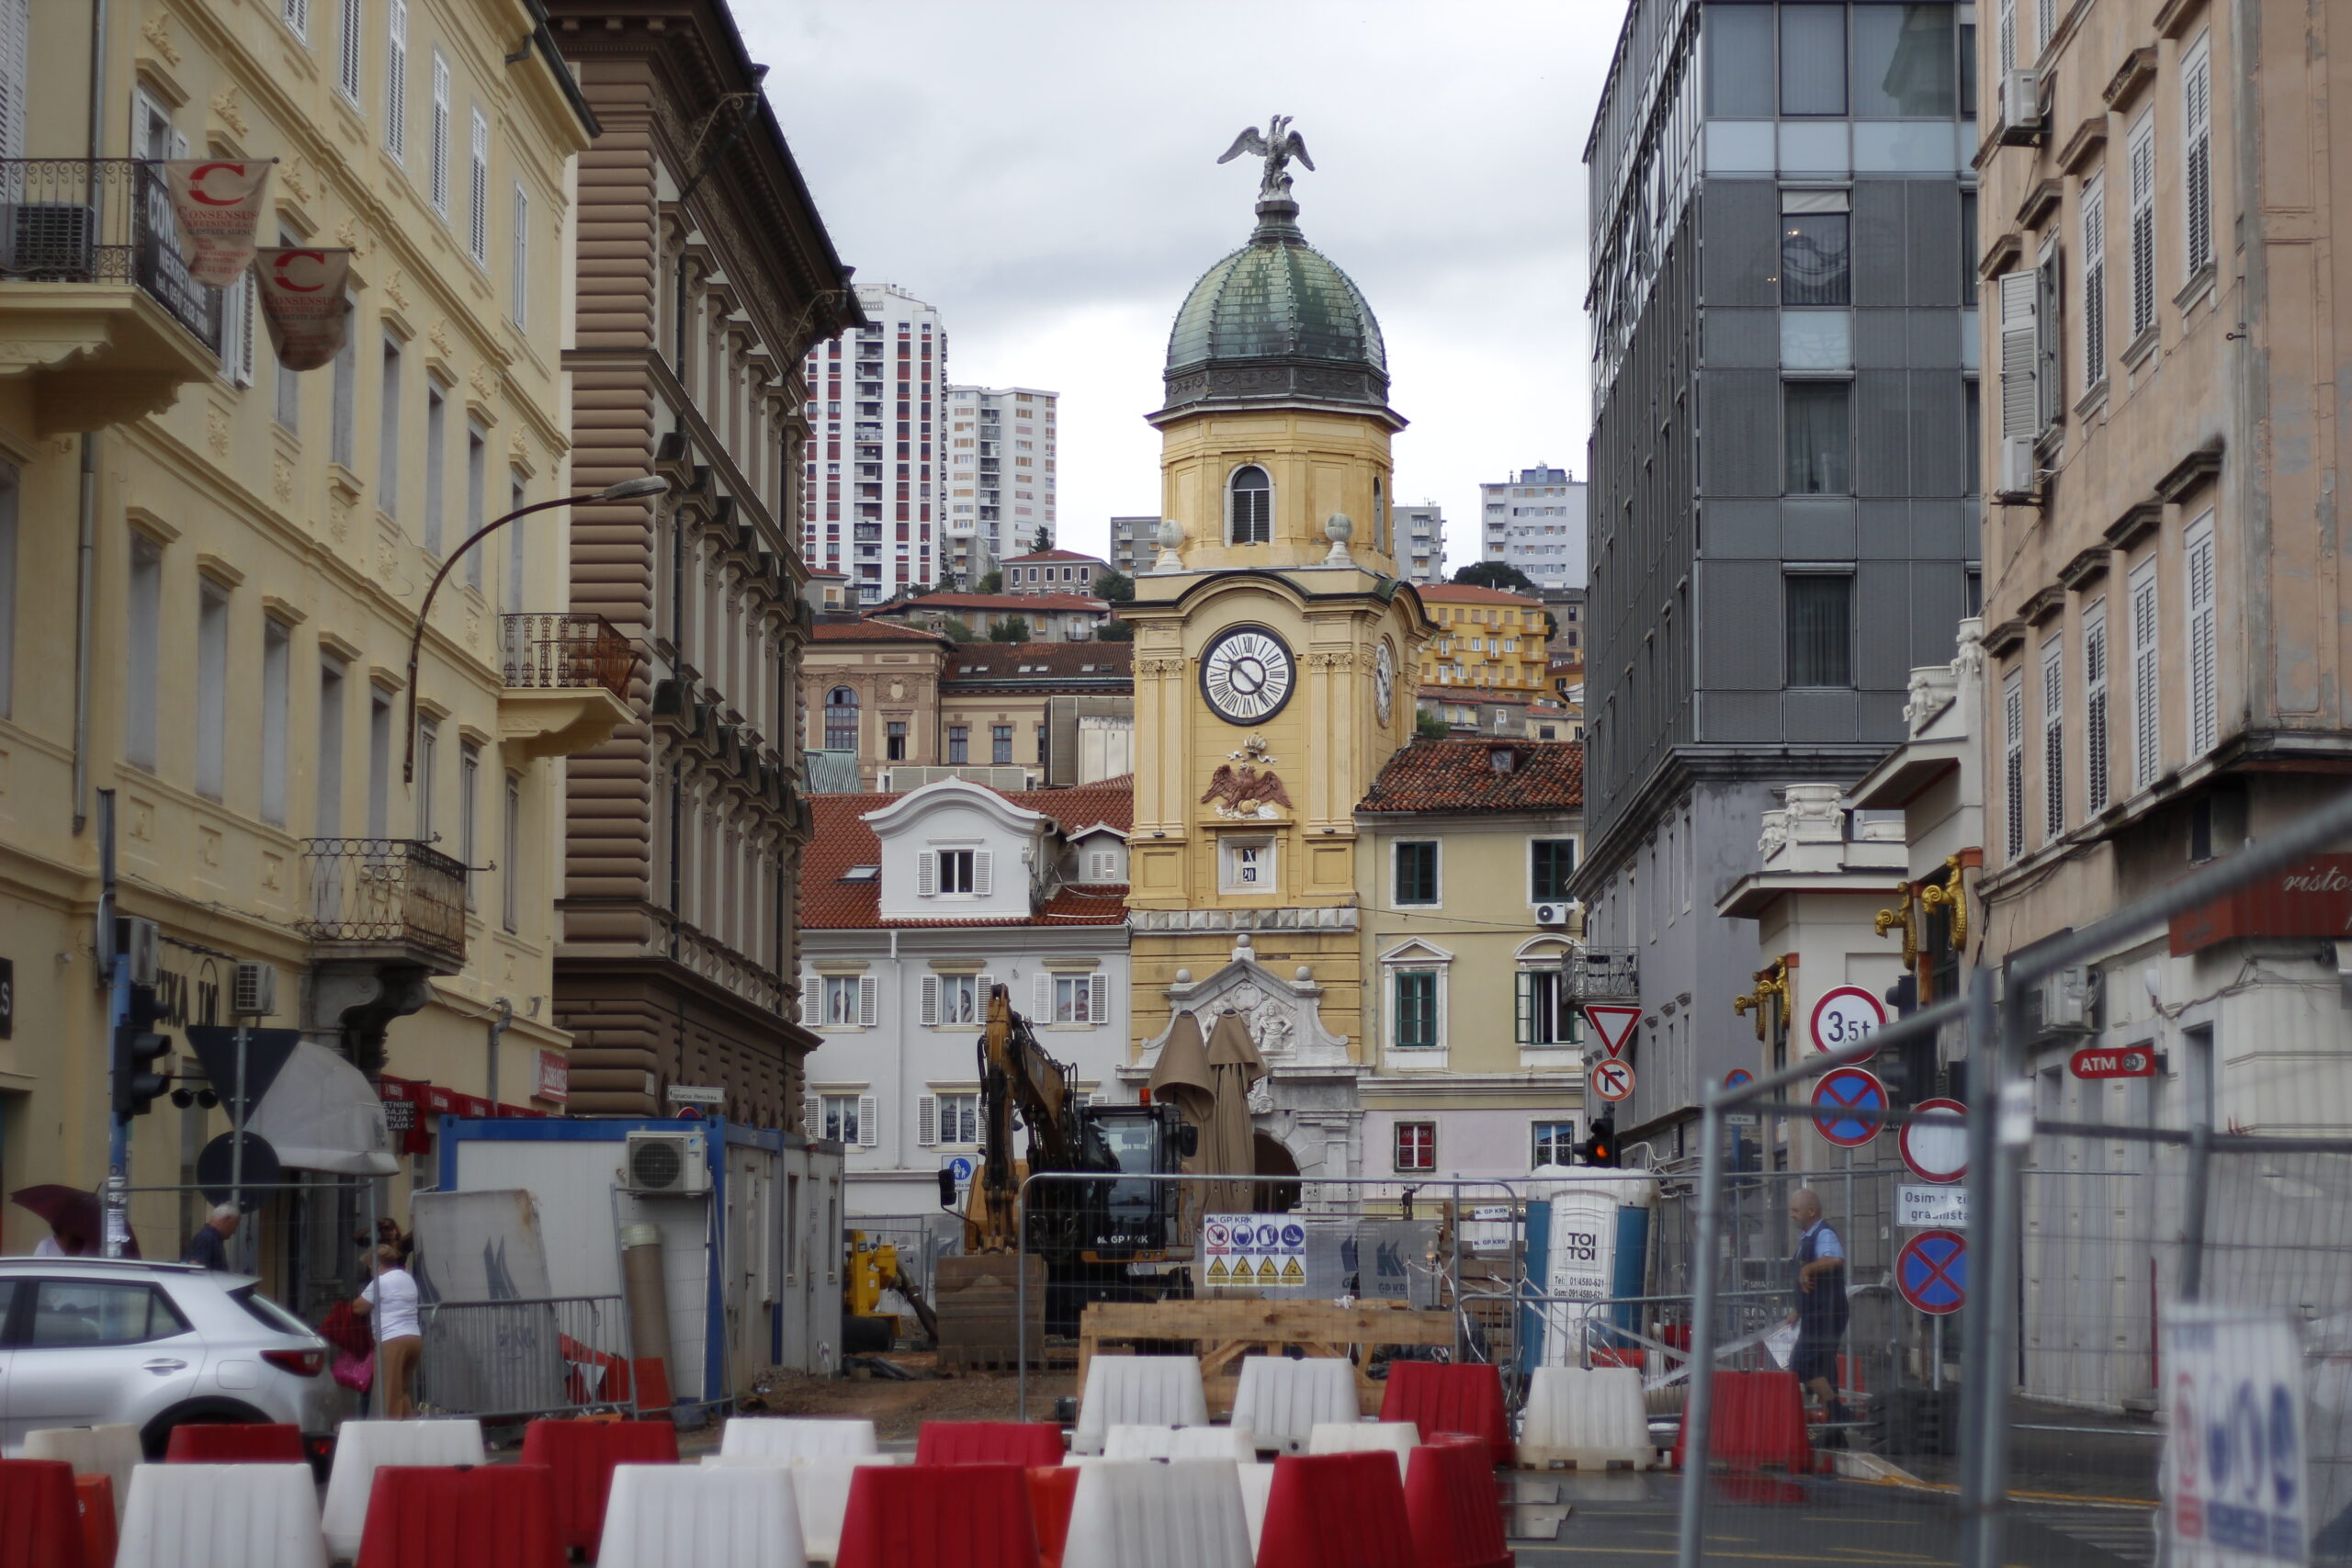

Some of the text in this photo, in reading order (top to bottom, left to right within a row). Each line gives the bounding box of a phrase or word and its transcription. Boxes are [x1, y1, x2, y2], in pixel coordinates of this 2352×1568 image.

[177, 206, 256, 220] CONSENSUS
[1245, 849, 1255, 862] X
[1243, 868, 1254, 882] 20
[2283, 866, 2352, 892] risto
[2080, 1056, 2117, 1071] ATM
[1905, 1191, 1935, 1203] Osim
[1111, 1235, 1125, 1244] GP
[1567, 1233, 1596, 1247] TOI
[1567, 1247, 1595, 1260] TOI
